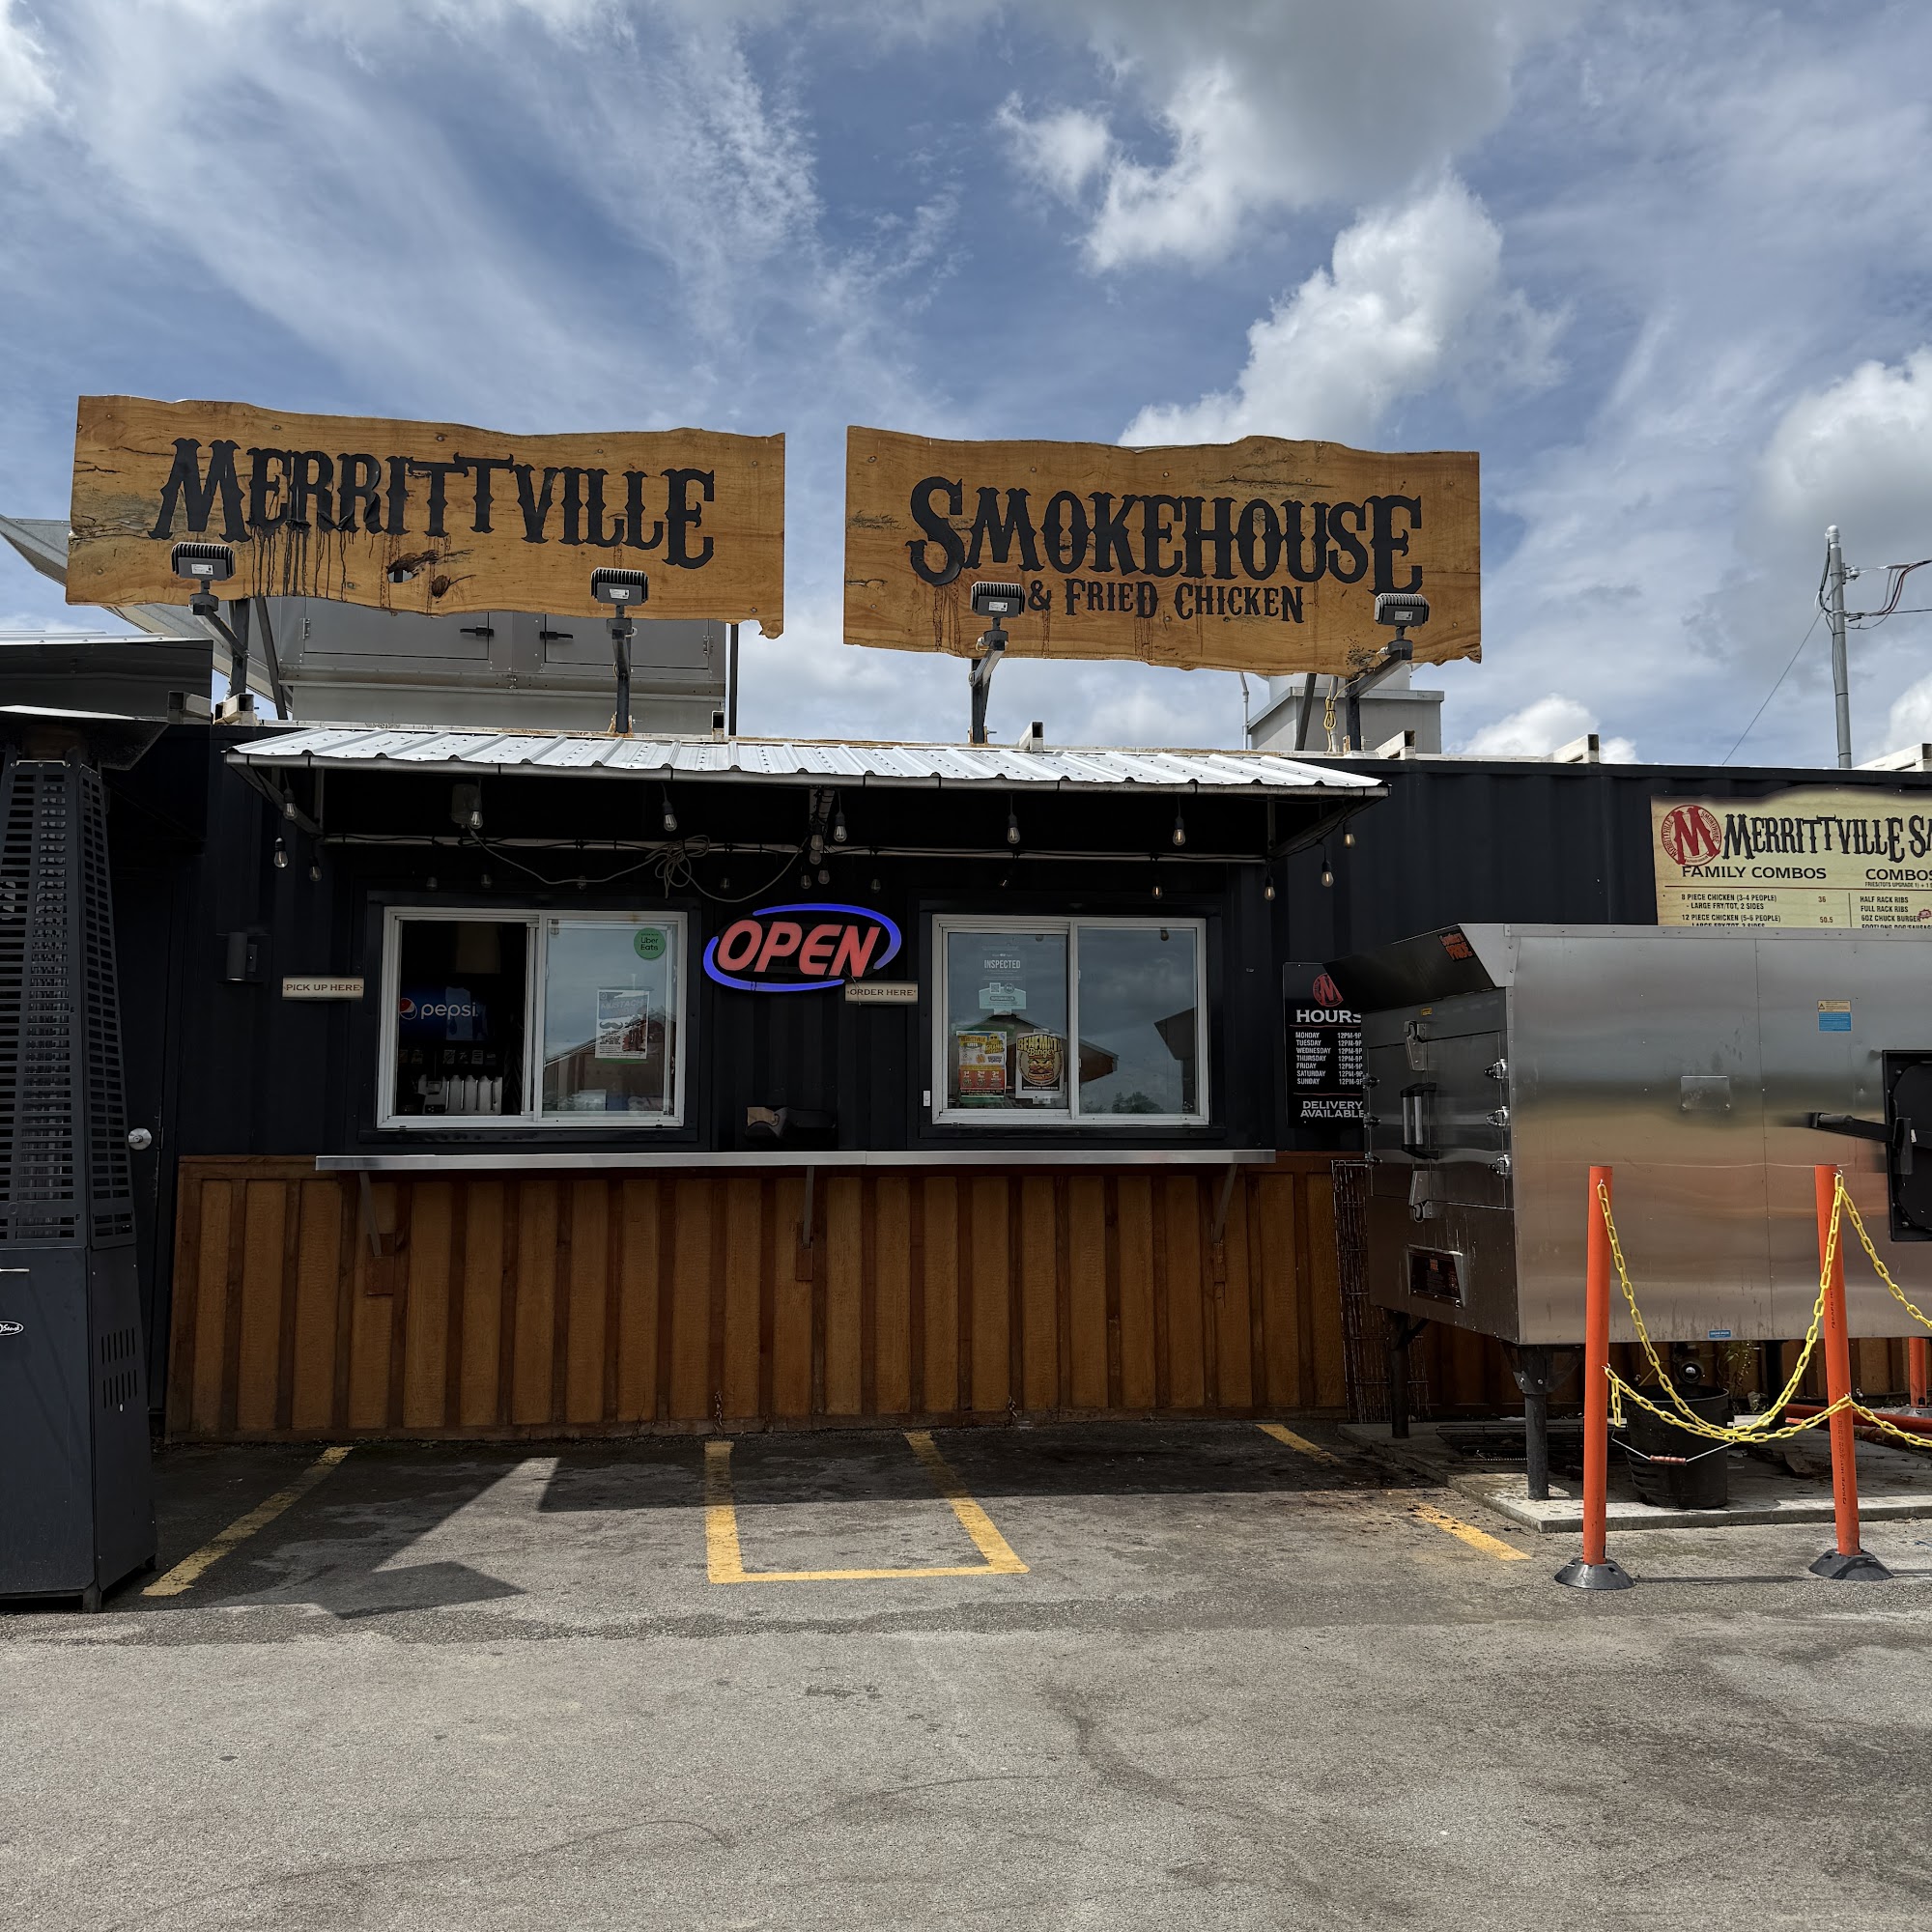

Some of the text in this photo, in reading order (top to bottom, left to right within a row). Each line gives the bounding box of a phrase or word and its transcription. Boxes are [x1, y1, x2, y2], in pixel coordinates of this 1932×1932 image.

[147, 438, 715, 569] MERRITTVILLE
[905, 475, 1422, 594] SMOKEHOUSE
[1028, 578, 1304, 624] & FRIED CHICKEN
[1721, 813, 1906, 864] MERRITTVILLE
[1682, 866, 1827, 879] FAMILY COMBOS
[717, 919, 882, 978] OPEN
[983, 959, 1021, 969] INSPECTED
[329, 983, 360, 992] HERE
[420, 1001, 477, 1020] pepsi
[1300, 1109, 1364, 1118] AVAILABLE
[1302, 1100, 1363, 1110] DELIVERY
